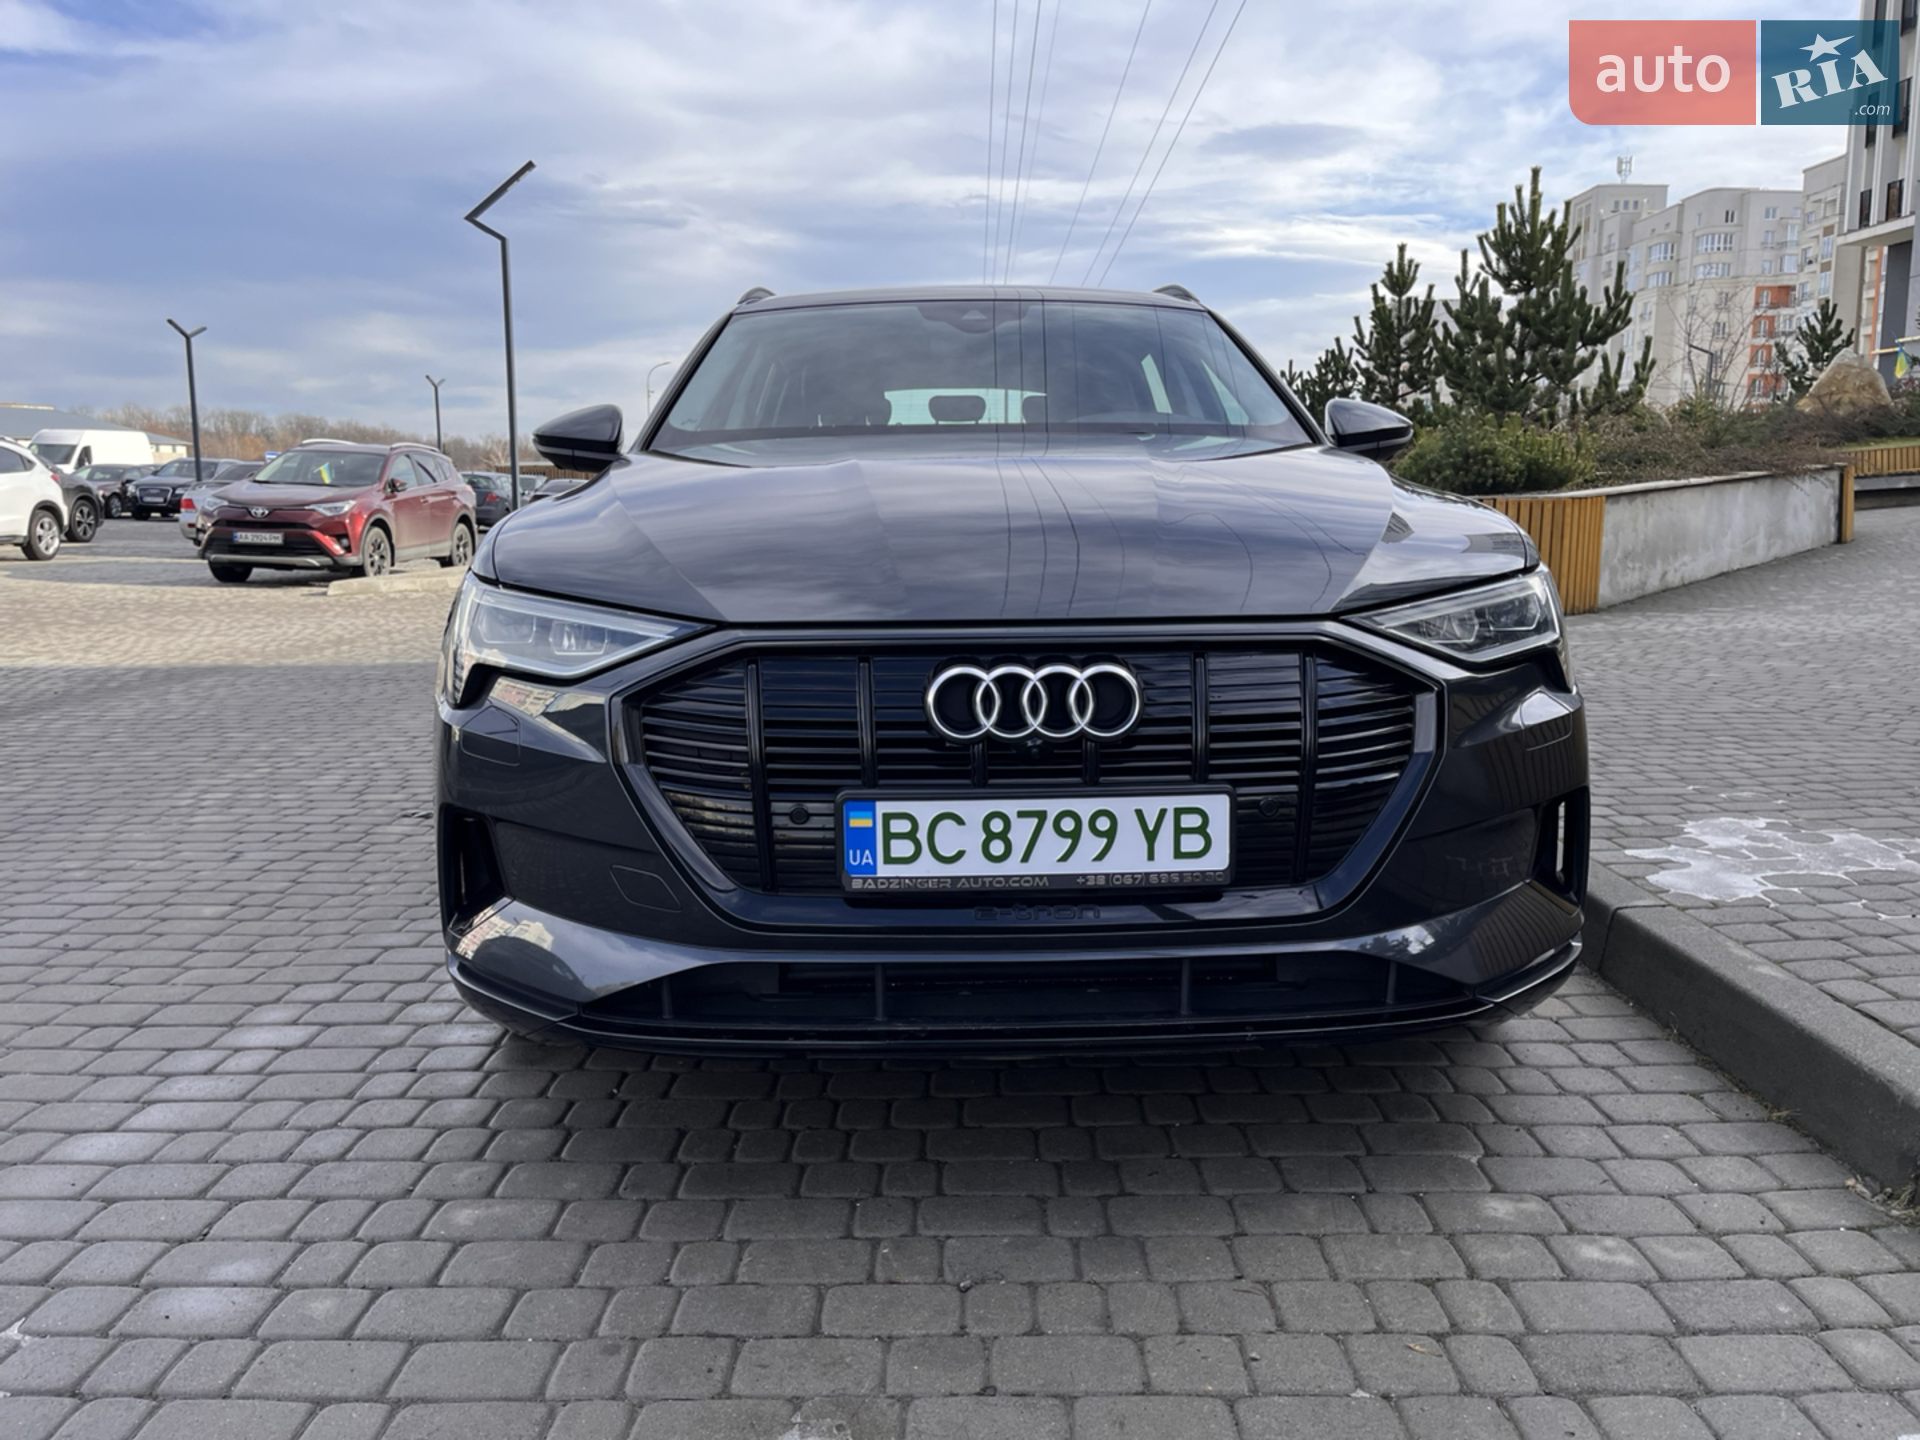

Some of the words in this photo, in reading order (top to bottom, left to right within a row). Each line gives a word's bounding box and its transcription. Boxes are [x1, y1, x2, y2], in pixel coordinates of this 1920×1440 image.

[882, 811, 967, 865] BC
[981, 809, 1118, 863] 8799
[1134, 806, 1212, 861] YB
[849, 849, 874, 866] UA
[852, 878, 951, 889] BADZINGER
[957, 876, 1049, 888] AUTO.COM
[1076, 875, 1106, 886] +38
[1109, 872, 1146, 887] (067)
[973, 903, 1100, 921] e-tron
